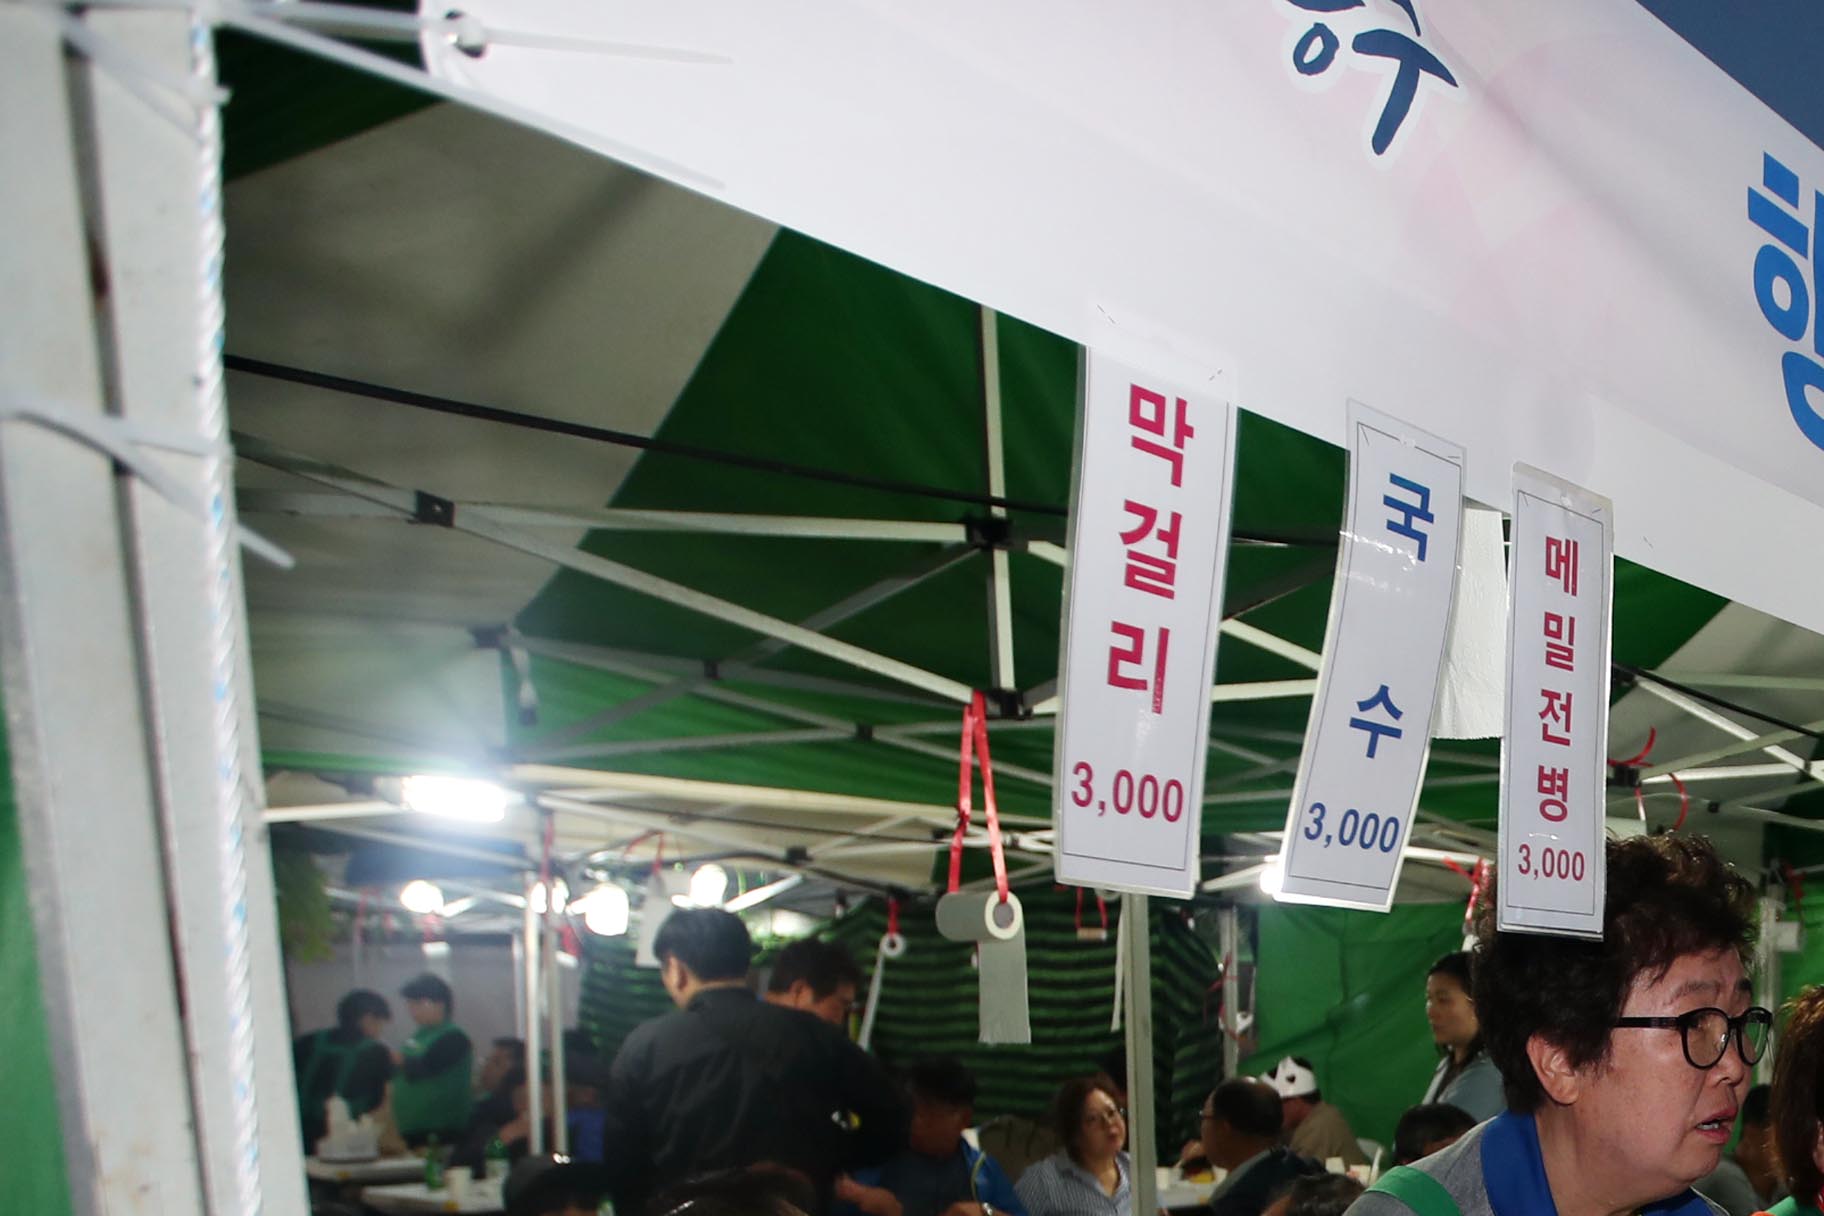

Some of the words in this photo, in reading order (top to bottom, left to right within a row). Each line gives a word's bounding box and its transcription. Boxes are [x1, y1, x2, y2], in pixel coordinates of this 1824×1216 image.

[1106, 383, 1195, 715] 막걸리
[1349, 472, 1436, 760] 국수
[1536, 535, 1581, 824] 메밀전병
[1071, 761, 1185, 824] 3,000
[1303, 802, 1401, 854] 3,000
[1517, 843, 1586, 882] 3,000
